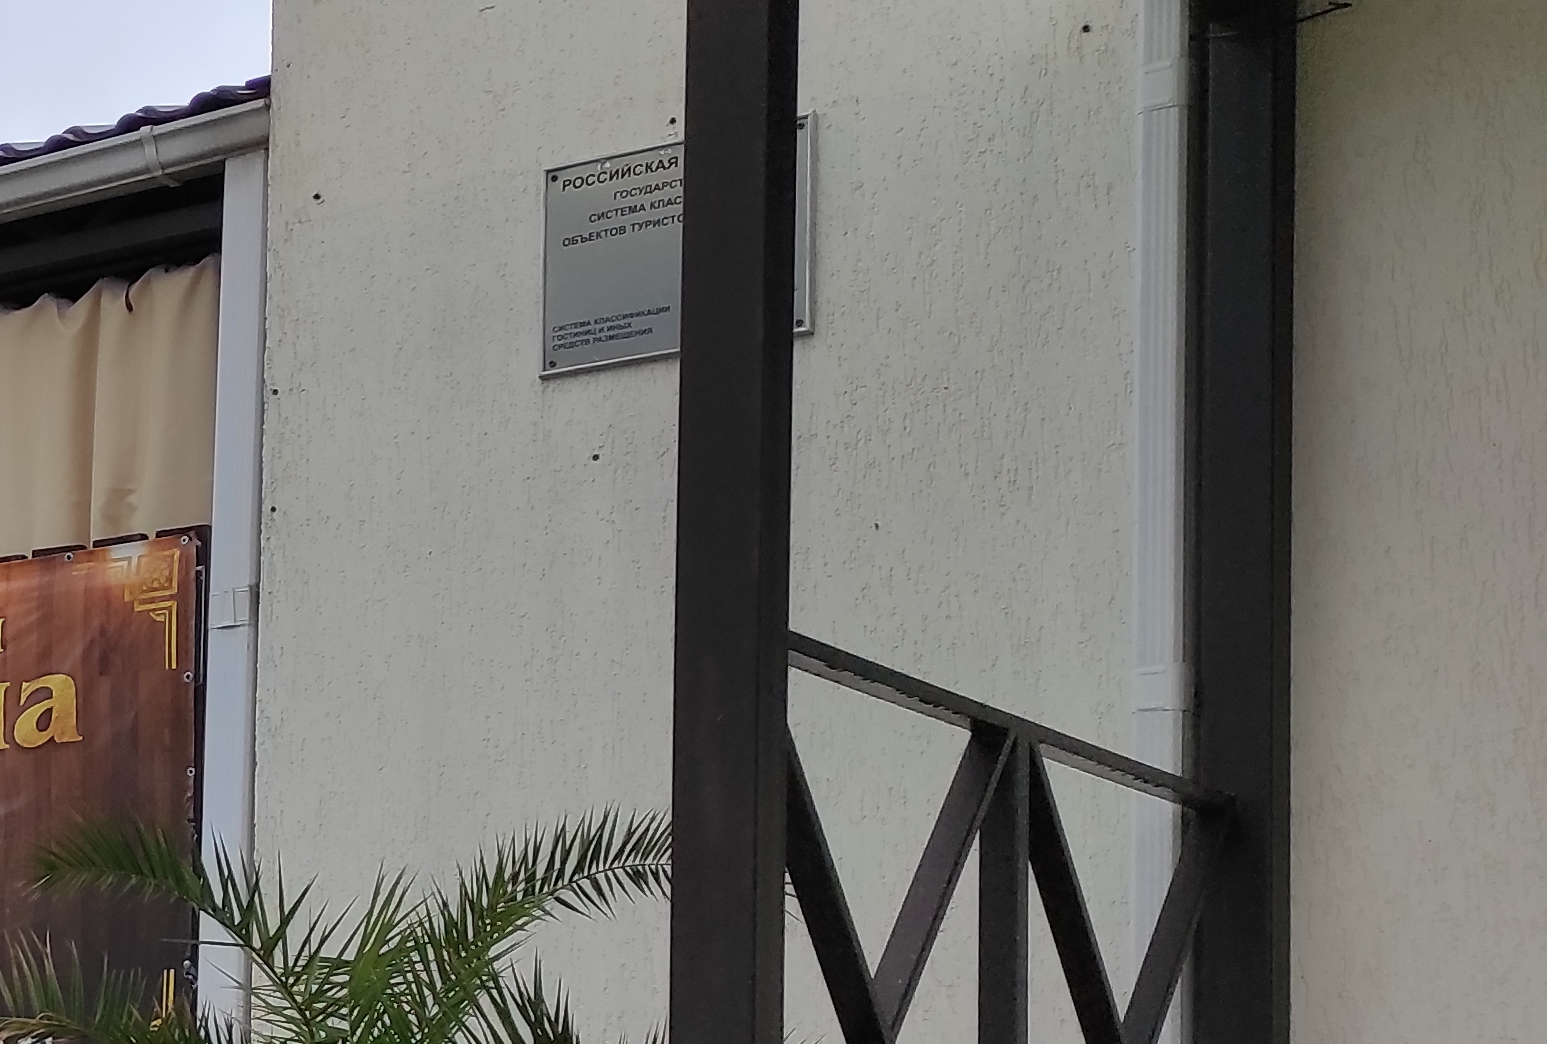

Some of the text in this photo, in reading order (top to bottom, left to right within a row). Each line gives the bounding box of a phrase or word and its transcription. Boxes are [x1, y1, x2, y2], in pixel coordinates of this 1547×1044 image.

[562, 156, 679, 192] РОССИЙСКАЯ
[588, 203, 647, 223] СИСТЕМА
[562, 225, 627, 247] ОБЪЕКТОВ
[552, 319, 591, 334] СИСТЕМА
